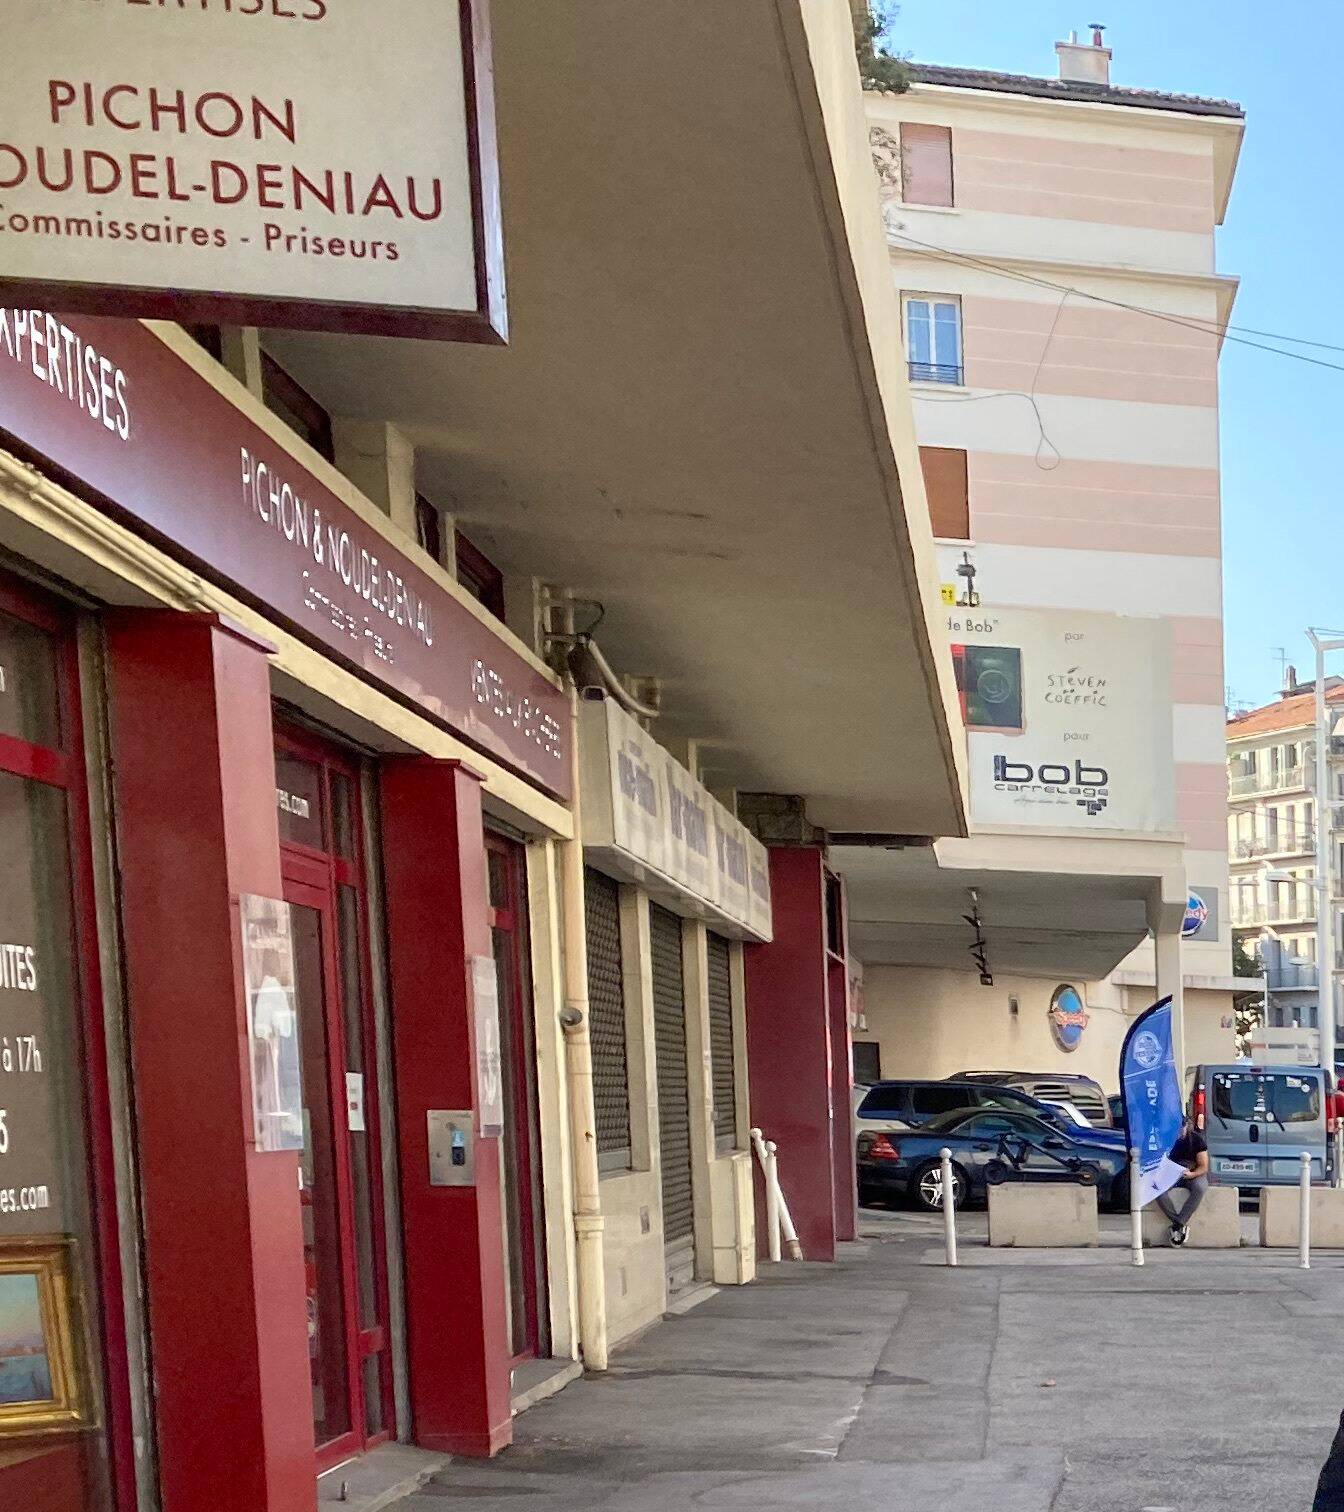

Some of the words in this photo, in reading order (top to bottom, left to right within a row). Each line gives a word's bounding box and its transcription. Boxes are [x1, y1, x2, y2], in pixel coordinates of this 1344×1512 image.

[49, 80, 297, 144] PICHON
[0, 209, 227, 249] ommissaires
[264, 223, 399, 262] Priseurs
[240, 447, 308, 548] PICHON
[312, 508, 325, 565] &
